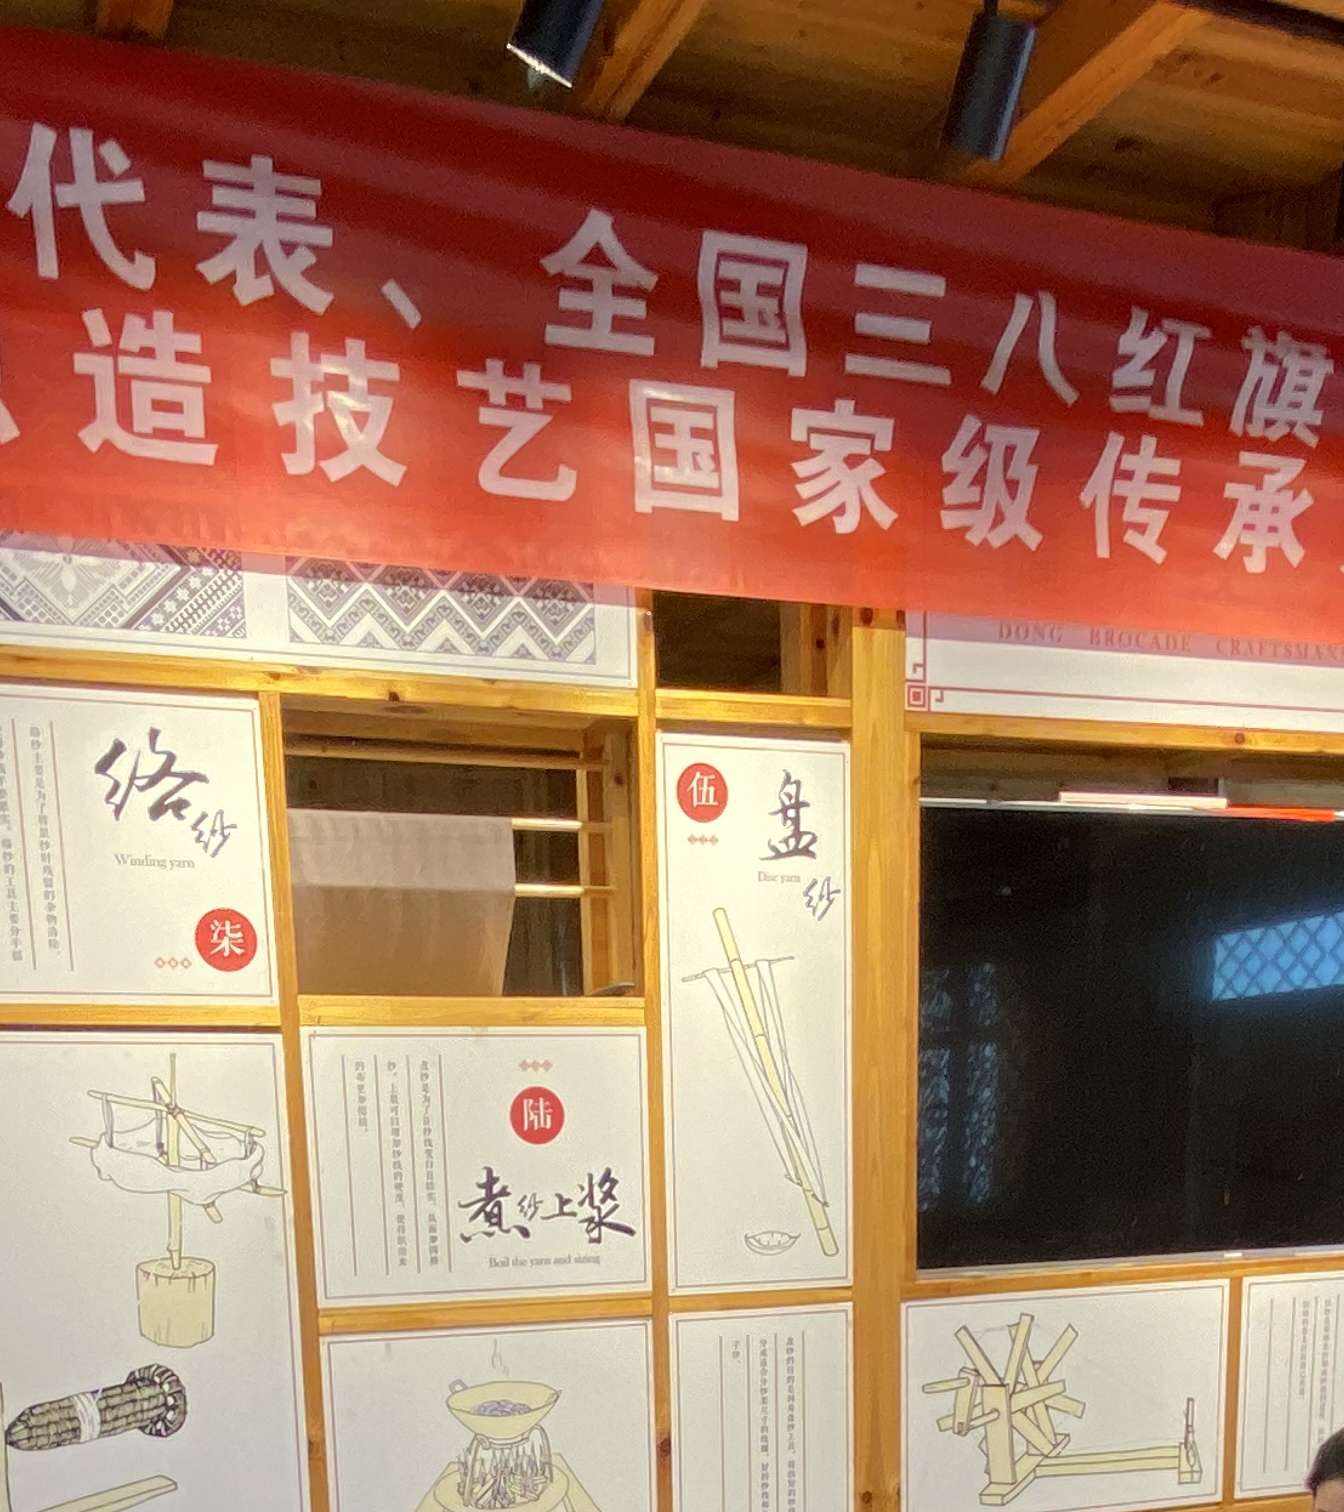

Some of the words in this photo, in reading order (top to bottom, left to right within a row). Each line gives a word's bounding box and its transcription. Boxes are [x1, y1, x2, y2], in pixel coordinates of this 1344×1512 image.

[998, 620, 1064, 645] DONG
[1088, 628, 1192, 655] BROCADE
[93, 726, 238, 860] 络纱
[688, 772, 719, 808] 伍
[114, 852, 166, 871] Winding
[168, 855, 196, 872] yarn
[759, 769, 841, 921] 盘纱
[209, 918, 246, 960] 柒
[523, 1096, 552, 1131] 陆
[457, 1166, 636, 1245] 煮纱上浆
